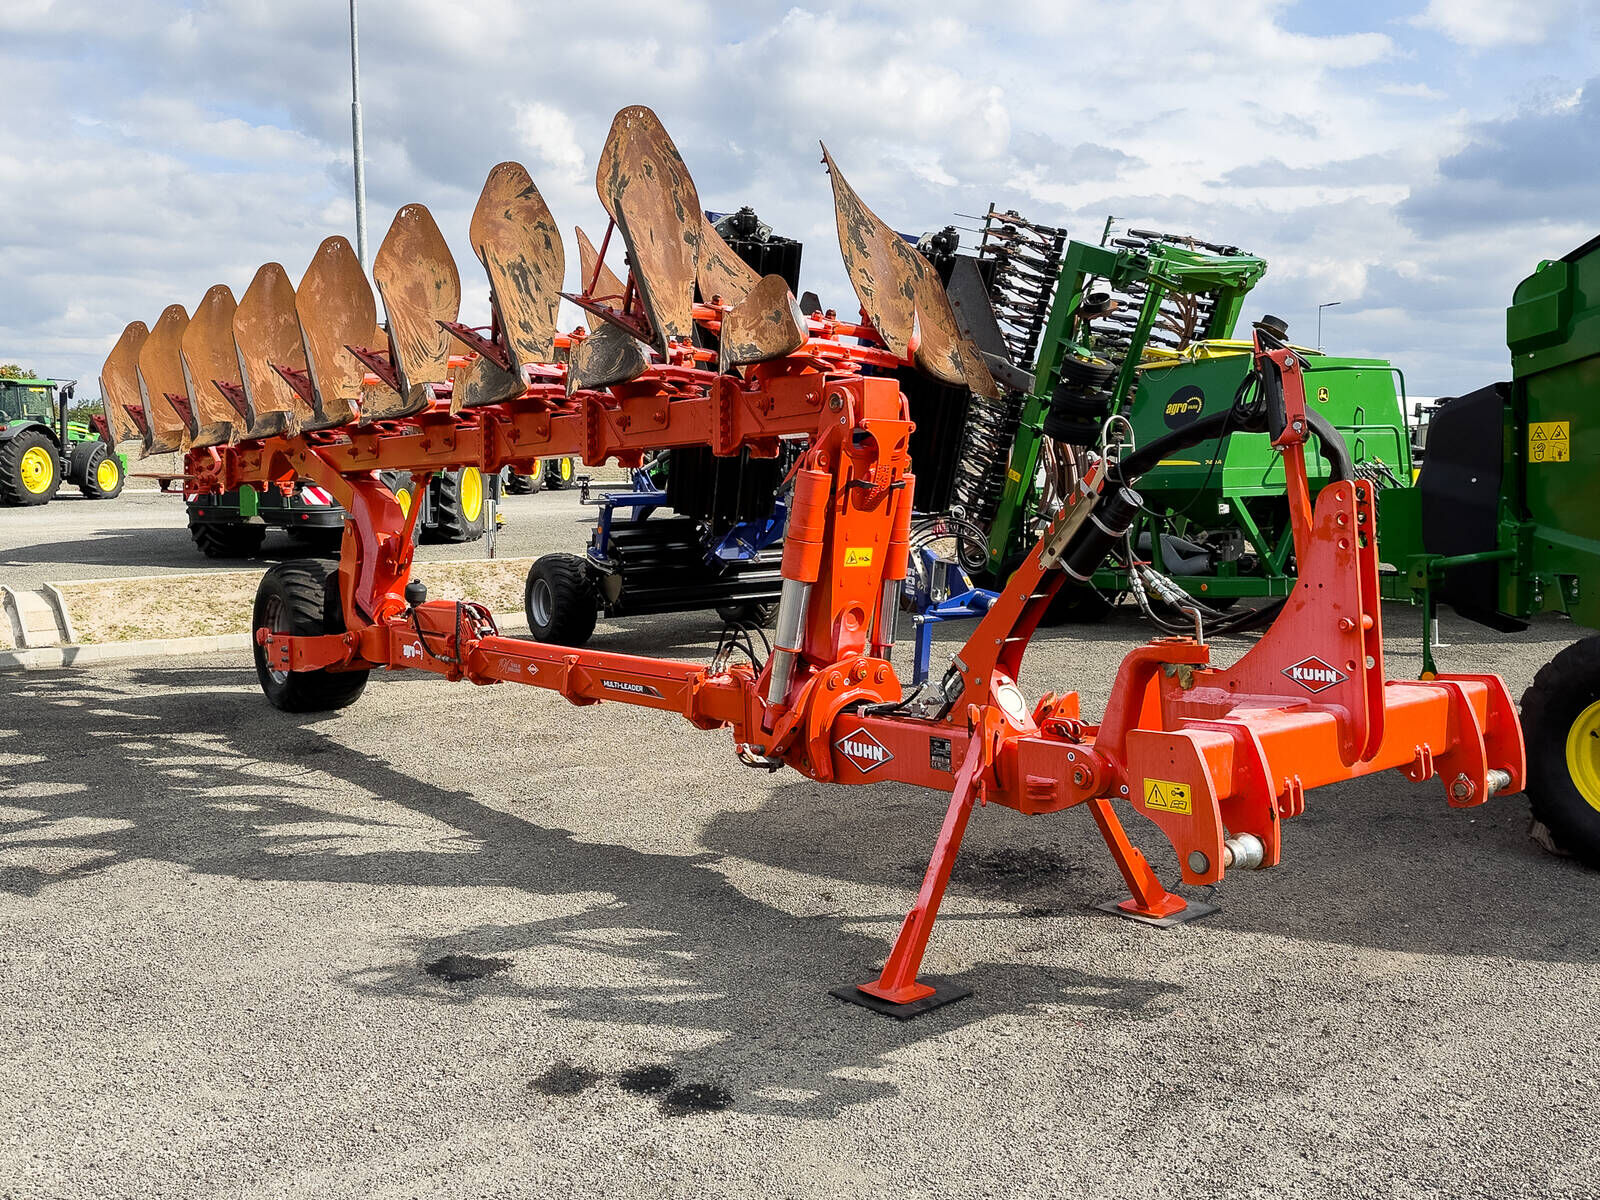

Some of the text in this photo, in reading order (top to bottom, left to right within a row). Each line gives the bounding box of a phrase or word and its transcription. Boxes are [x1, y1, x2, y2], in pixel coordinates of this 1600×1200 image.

[1165, 403, 1188, 416] agro
[1293, 667, 1337, 682] KUHN
[603, 680, 644, 692] MULTI-LEADER
[844, 740, 883, 761] KUHN
